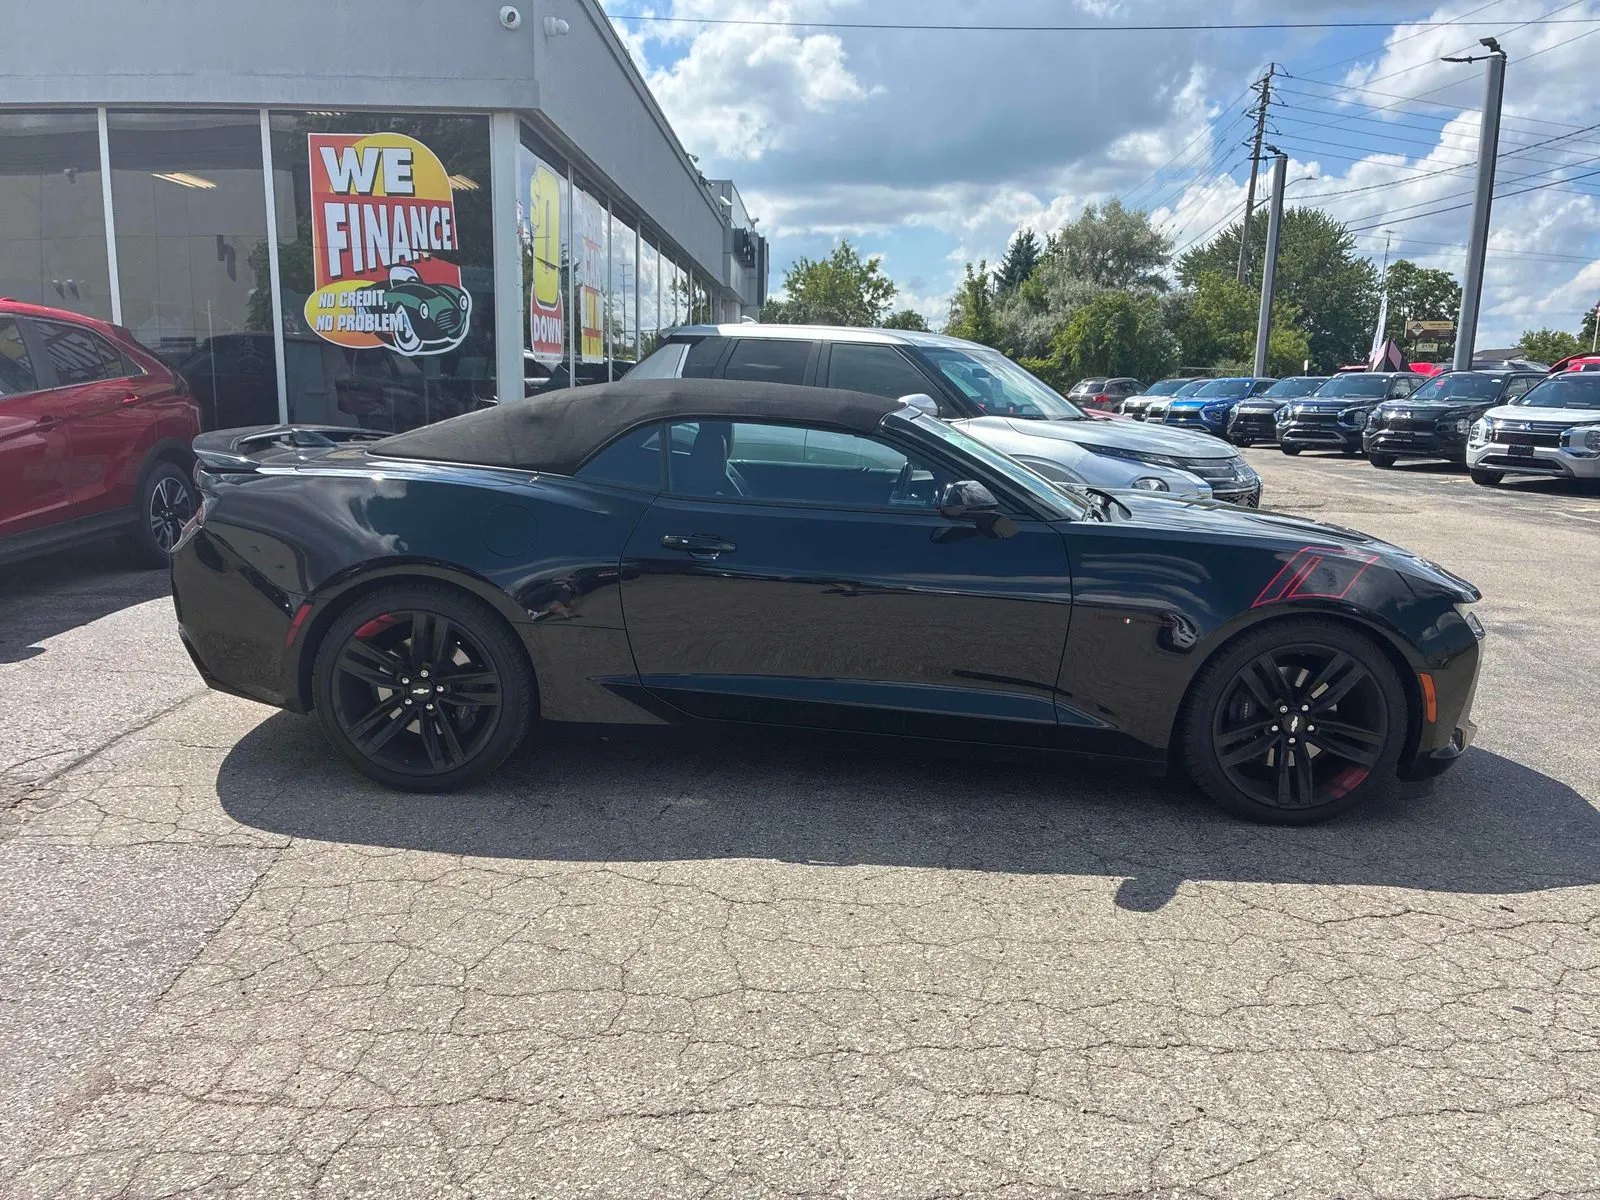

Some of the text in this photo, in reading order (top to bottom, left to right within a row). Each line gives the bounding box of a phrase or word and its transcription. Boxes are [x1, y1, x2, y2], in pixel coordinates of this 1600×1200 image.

[319, 146, 415, 196] WE
[323, 202, 453, 279] FINANCE
[318, 289, 388, 309] NO CREDIT,
[315, 313, 404, 332] NO PROBLEM
[533, 313, 562, 345] DOWN
